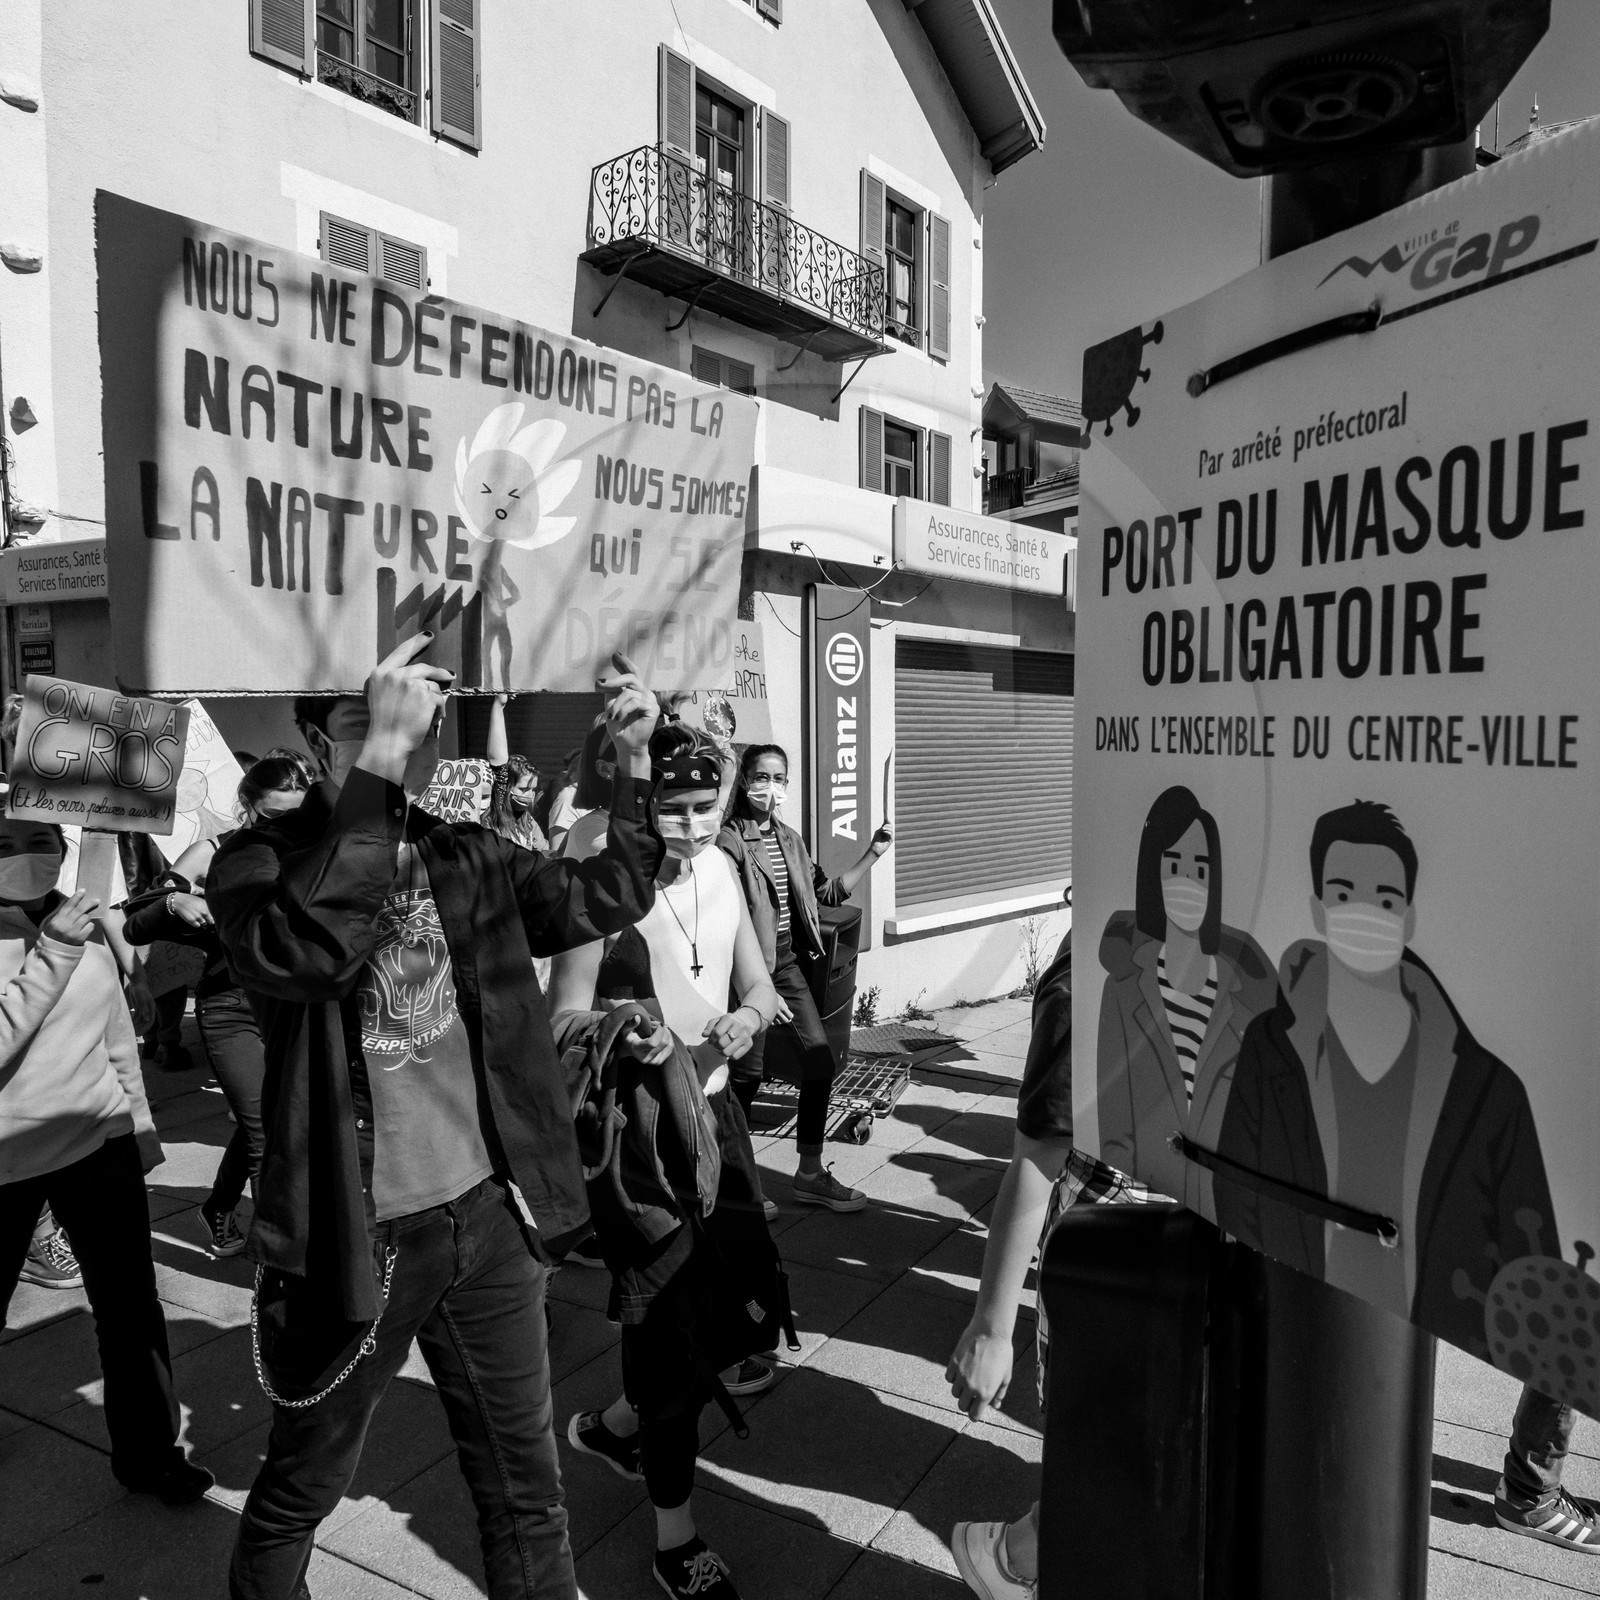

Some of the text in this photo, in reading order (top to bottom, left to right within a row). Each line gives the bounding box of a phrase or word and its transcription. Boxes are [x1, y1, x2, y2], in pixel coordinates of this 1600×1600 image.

[1410, 214, 1541, 291] Gap
[1445, 220, 1460, 235] de
[183, 237, 724, 438] NOUS NE DÉFENDONS PAS LA
[184, 348, 433, 472] NATURE
[1200, 391, 1407, 478] Par arrêté préfectoral
[595, 454, 746, 518] NOUS SOMMES
[1102, 419, 1588, 597] PORT DU MASQUE
[139, 460, 473, 595] LA NATURE
[928, 515, 1048, 559] Assurances, Santé &
[17, 554, 72, 573] Assurances,
[72, 548, 101, 568] Santé
[18, 571, 106, 593] Services financiers
[666, 536, 724, 592] SE
[928, 542, 1040, 580] Services financiers
[565, 587, 732, 670] DÉFEND
[1142, 573, 1487, 686] OBLIGATOIRE
[43, 684, 177, 735] ON EN A
[726, 669, 768, 699] ARTH
[28, 717, 179, 792] GROS
[831, 697, 857, 841] Allianz
[1095, 715, 1579, 768] DANS L'ENSEMBLE DU CENTRE-VILLE
[32, 788, 54, 811] les
[57, 799, 86, 813] ours
